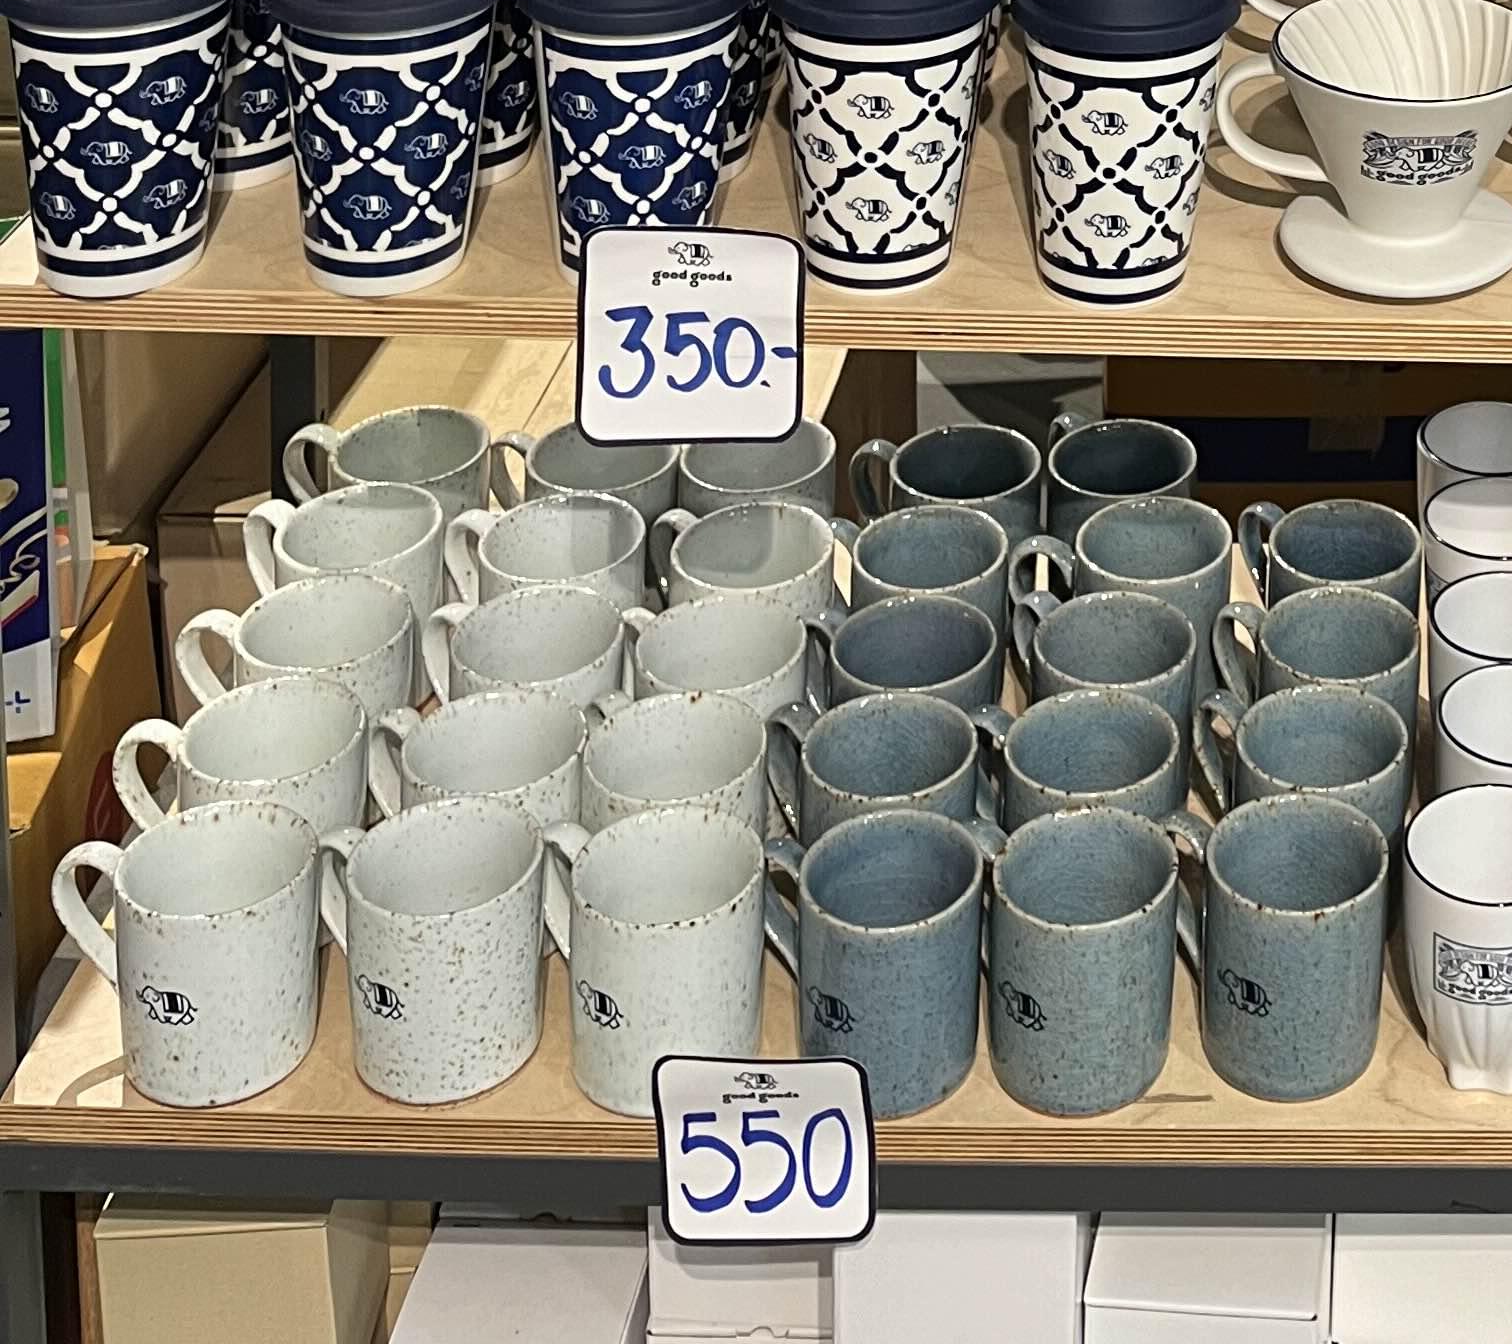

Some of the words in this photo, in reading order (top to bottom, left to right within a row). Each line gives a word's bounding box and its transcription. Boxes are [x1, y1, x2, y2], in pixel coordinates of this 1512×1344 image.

[652, 270, 687, 286] good
[689, 271, 733, 287] goods
[721, 1092, 756, 1104] good
[758, 1091, 799, 1103] goods
[681, 1108, 853, 1213] 550
